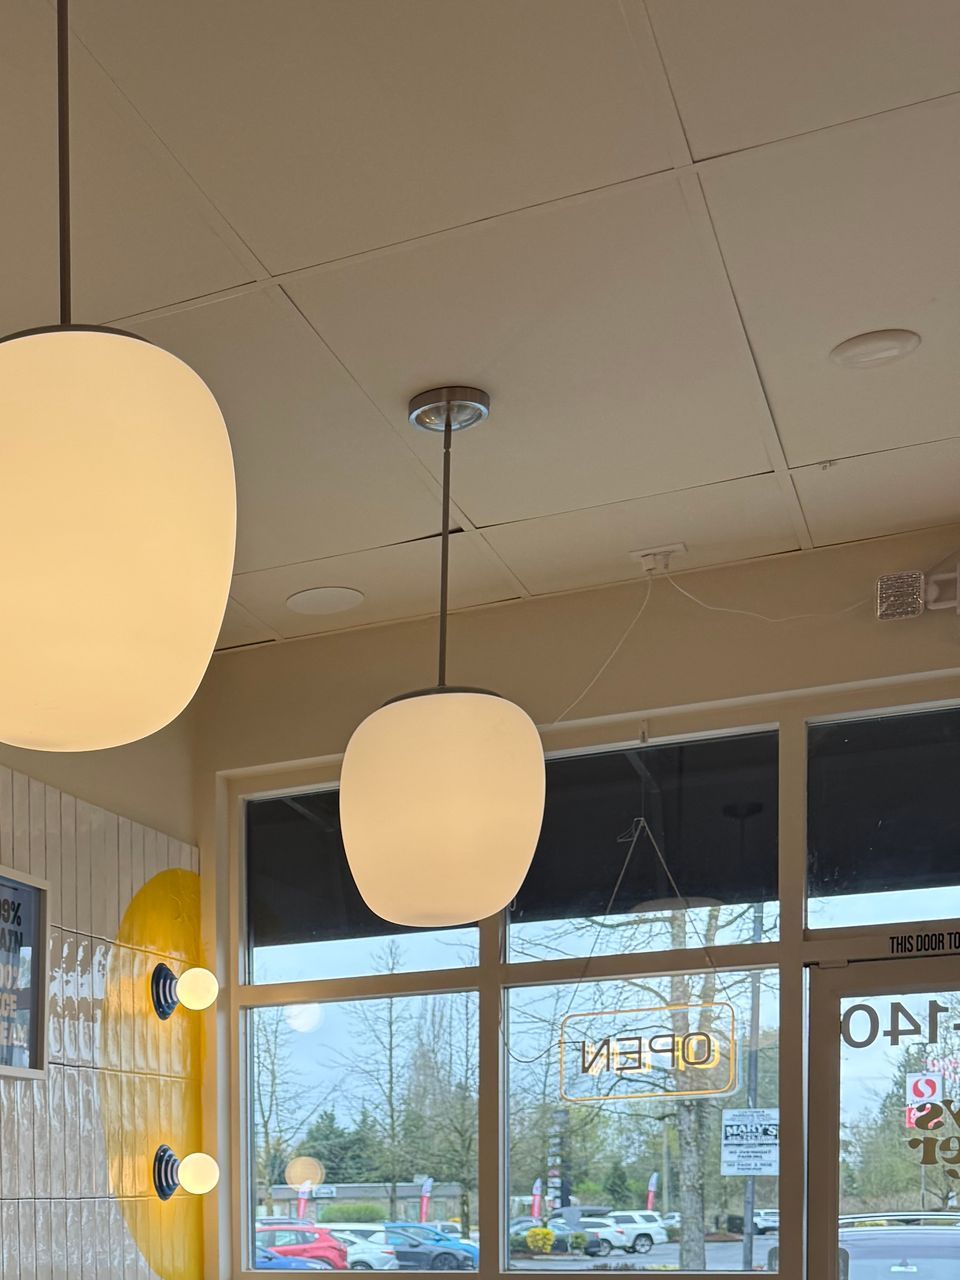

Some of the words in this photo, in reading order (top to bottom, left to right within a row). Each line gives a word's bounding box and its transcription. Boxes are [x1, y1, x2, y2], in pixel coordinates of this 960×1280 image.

[889, 936, 914, 954] THIS
[916, 933, 945, 952] DOOR
[947, 931, 960, 950] TO
[725, 1124, 778, 1137] MARY'S
